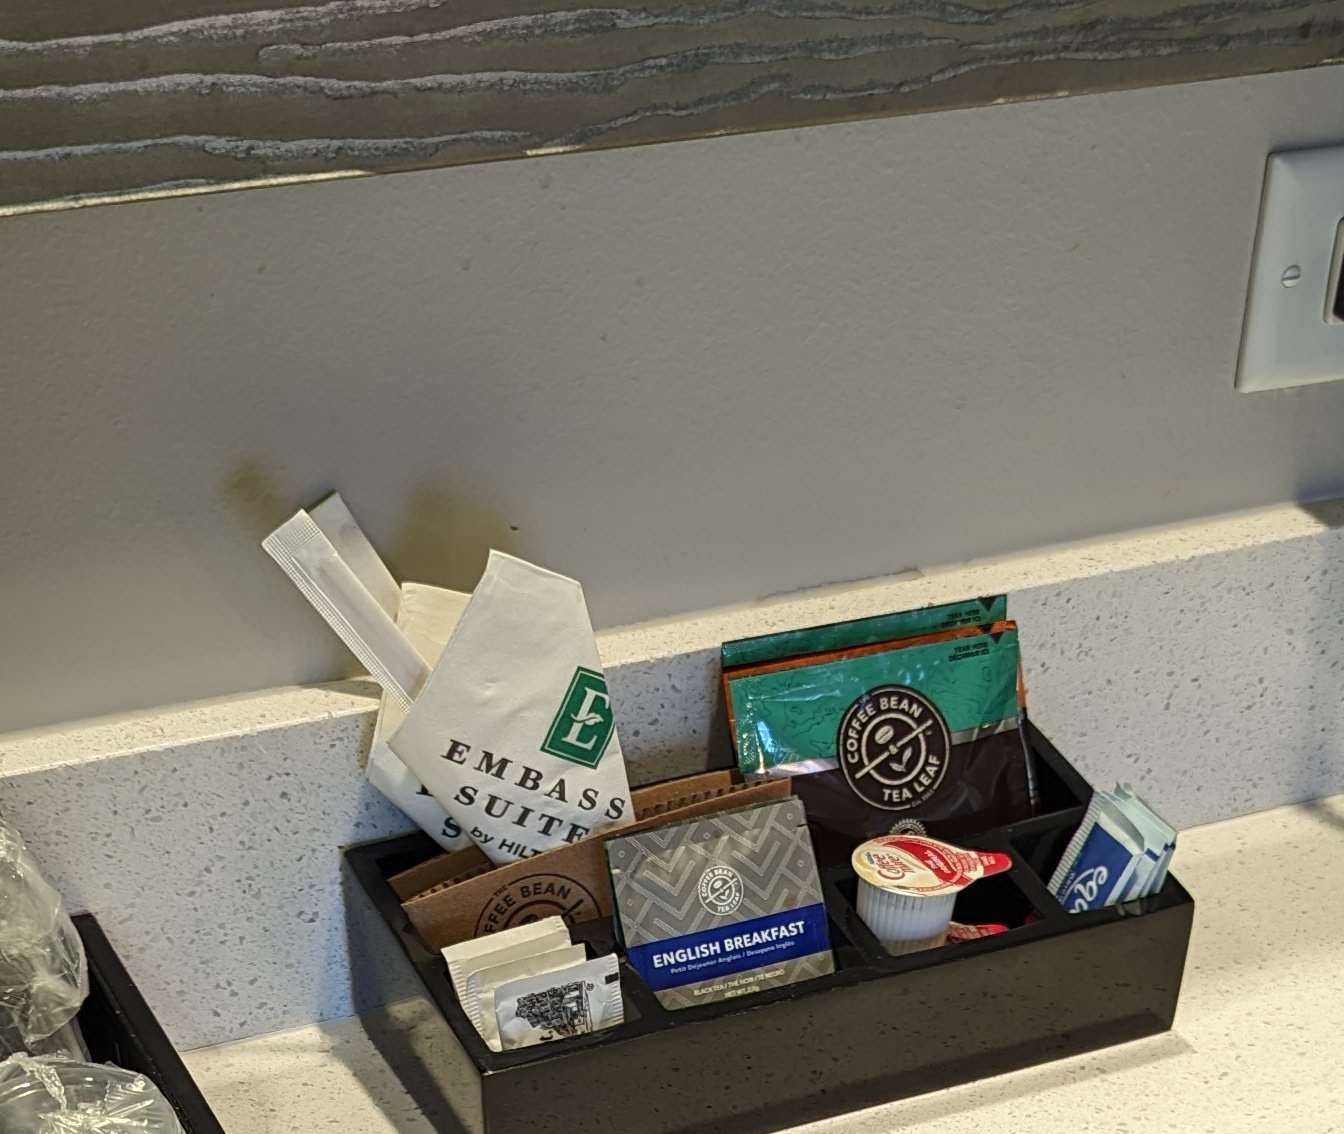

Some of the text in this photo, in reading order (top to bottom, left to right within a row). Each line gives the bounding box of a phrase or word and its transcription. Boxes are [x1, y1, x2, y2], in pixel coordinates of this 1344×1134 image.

[846, 696, 923, 764] COFFEE BEAN
[440, 738, 626, 820] EMBASS
[882, 754, 942, 802] TEA LEAF
[453, 785, 591, 844] SUITE
[470, 826, 495, 844] by
[484, 882, 571, 934] FFEE BEAN
[1068, 866, 1108, 914] equ
[652, 920, 806, 969] ENGLISH BREAKFAST
